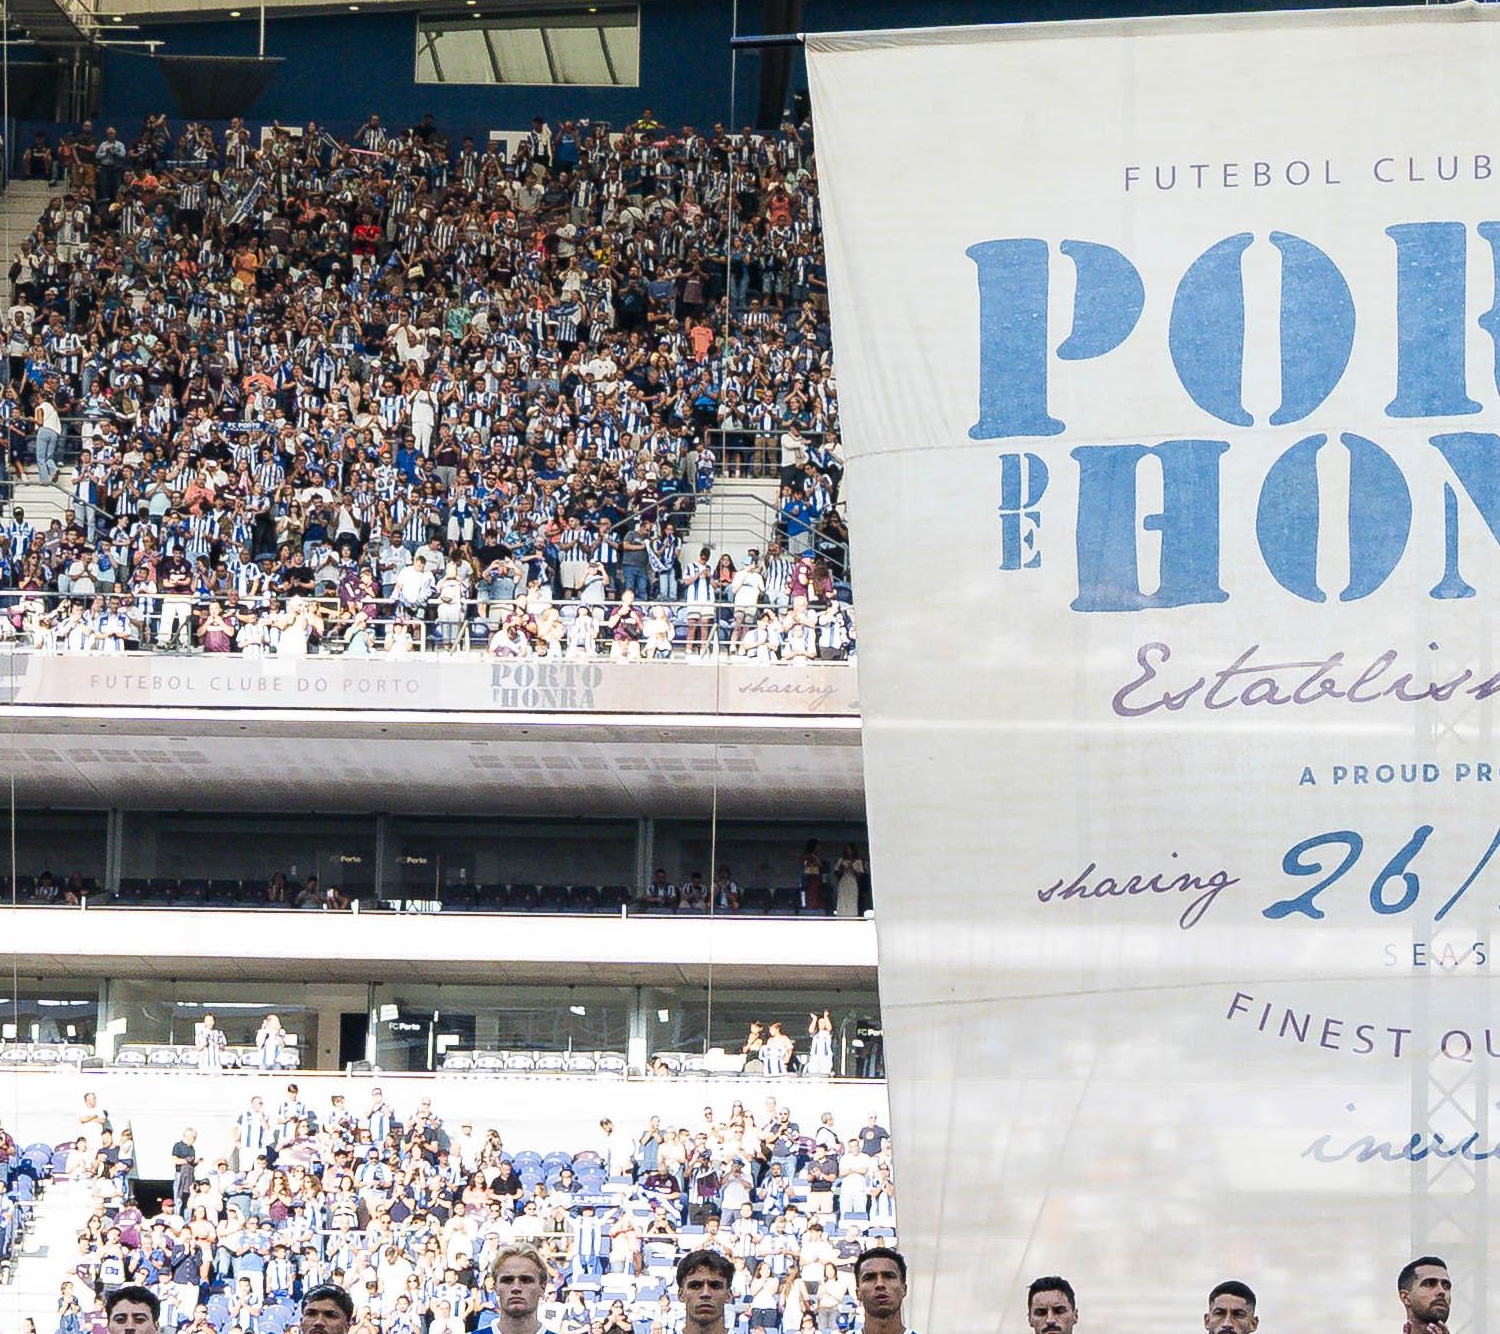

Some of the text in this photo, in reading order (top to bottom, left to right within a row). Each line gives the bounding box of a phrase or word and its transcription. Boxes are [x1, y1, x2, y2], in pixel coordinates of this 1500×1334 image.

[1123, 161, 1343, 192] FUTEBOL
[91, 674, 420, 694] FUTEBOL CLUBE DO PORTO
[490, 664, 603, 688] PORTO
[501, 687, 596, 708] HONRA
[738, 674, 838, 710] sharing
[1298, 766, 1318, 786] A
[1332, 764, 1441, 785] PROUD
[1036, 853, 1241, 929] sharing
[1226, 990, 1409, 1060] FINEST
